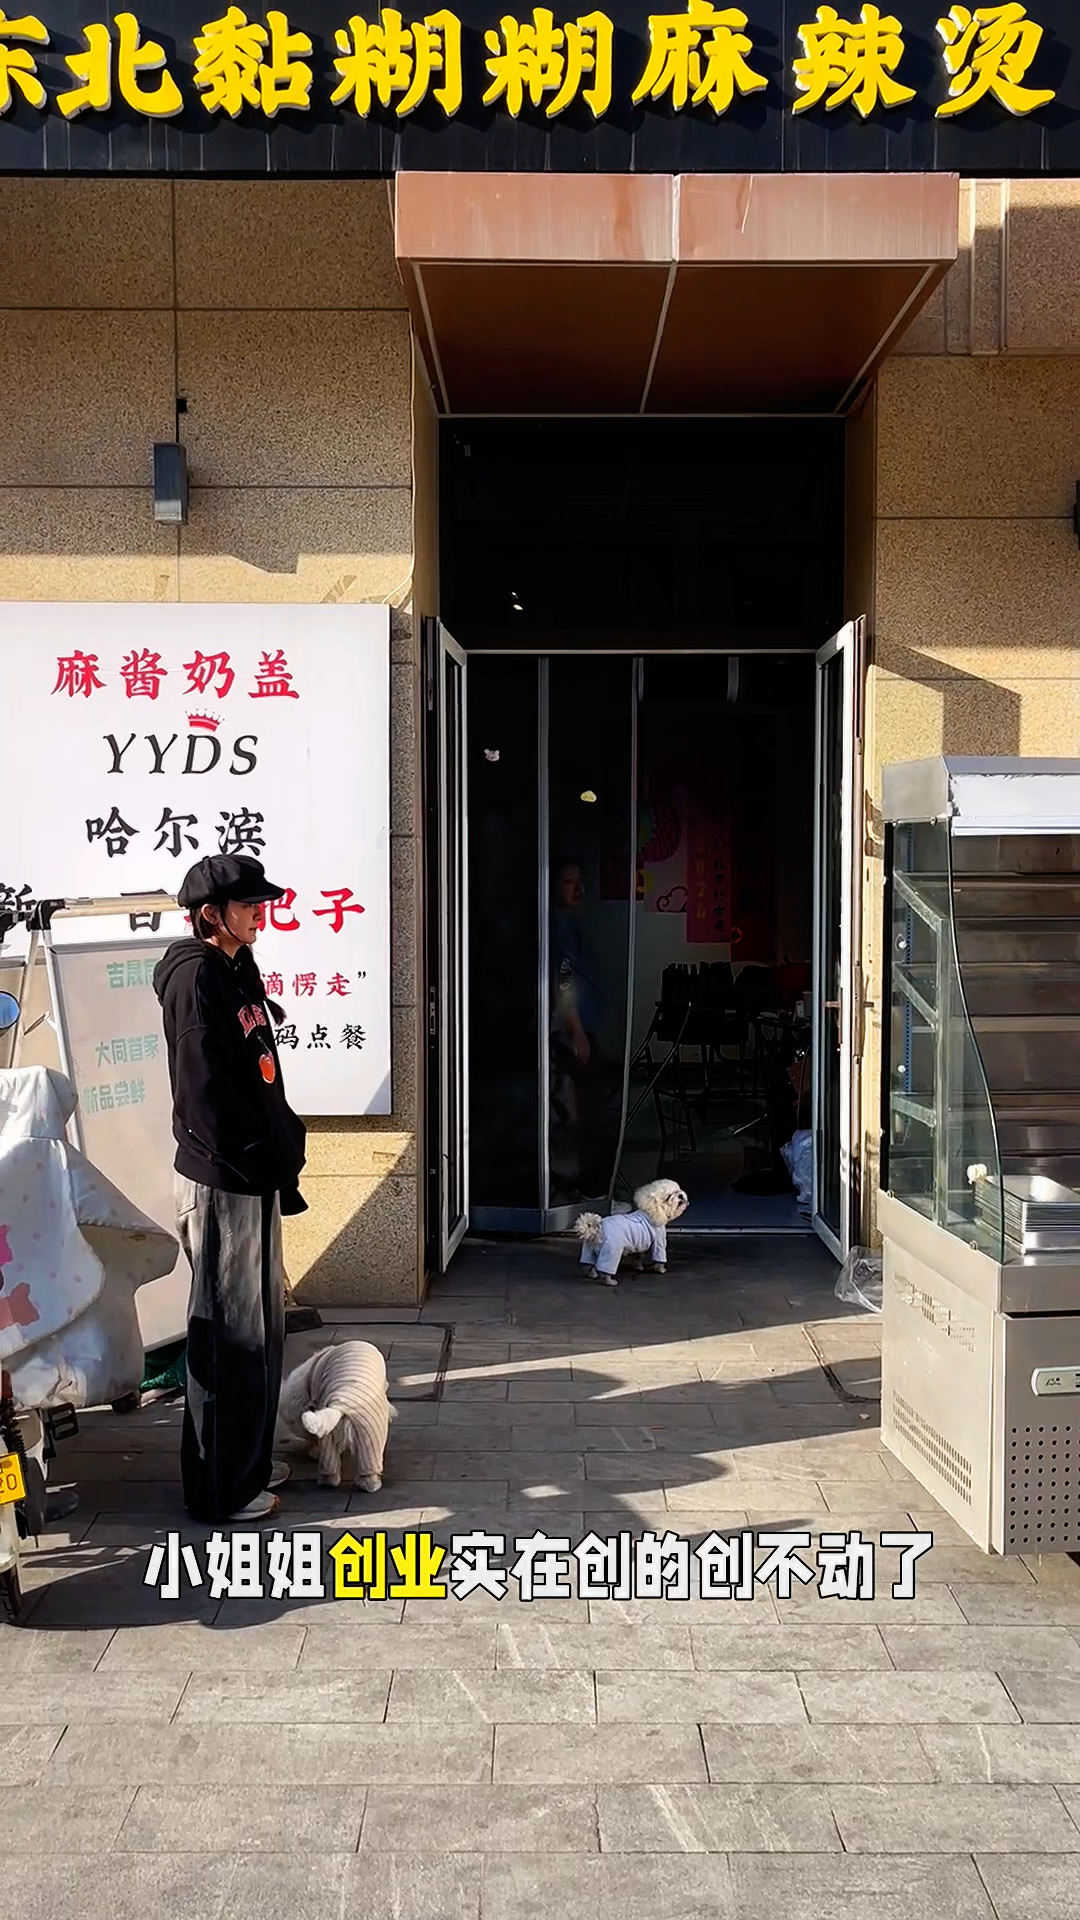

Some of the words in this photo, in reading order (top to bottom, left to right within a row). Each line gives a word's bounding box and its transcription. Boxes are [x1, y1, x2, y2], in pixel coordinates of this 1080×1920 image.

[51, 648, 301, 701] 麻酱奶盖
[104, 734, 260, 776] YYDS
[86, 806, 267, 859] 哈尔滨
[95, 1032, 159, 1068] 大同首家
[274, 1024, 367, 1051] 码点餐
